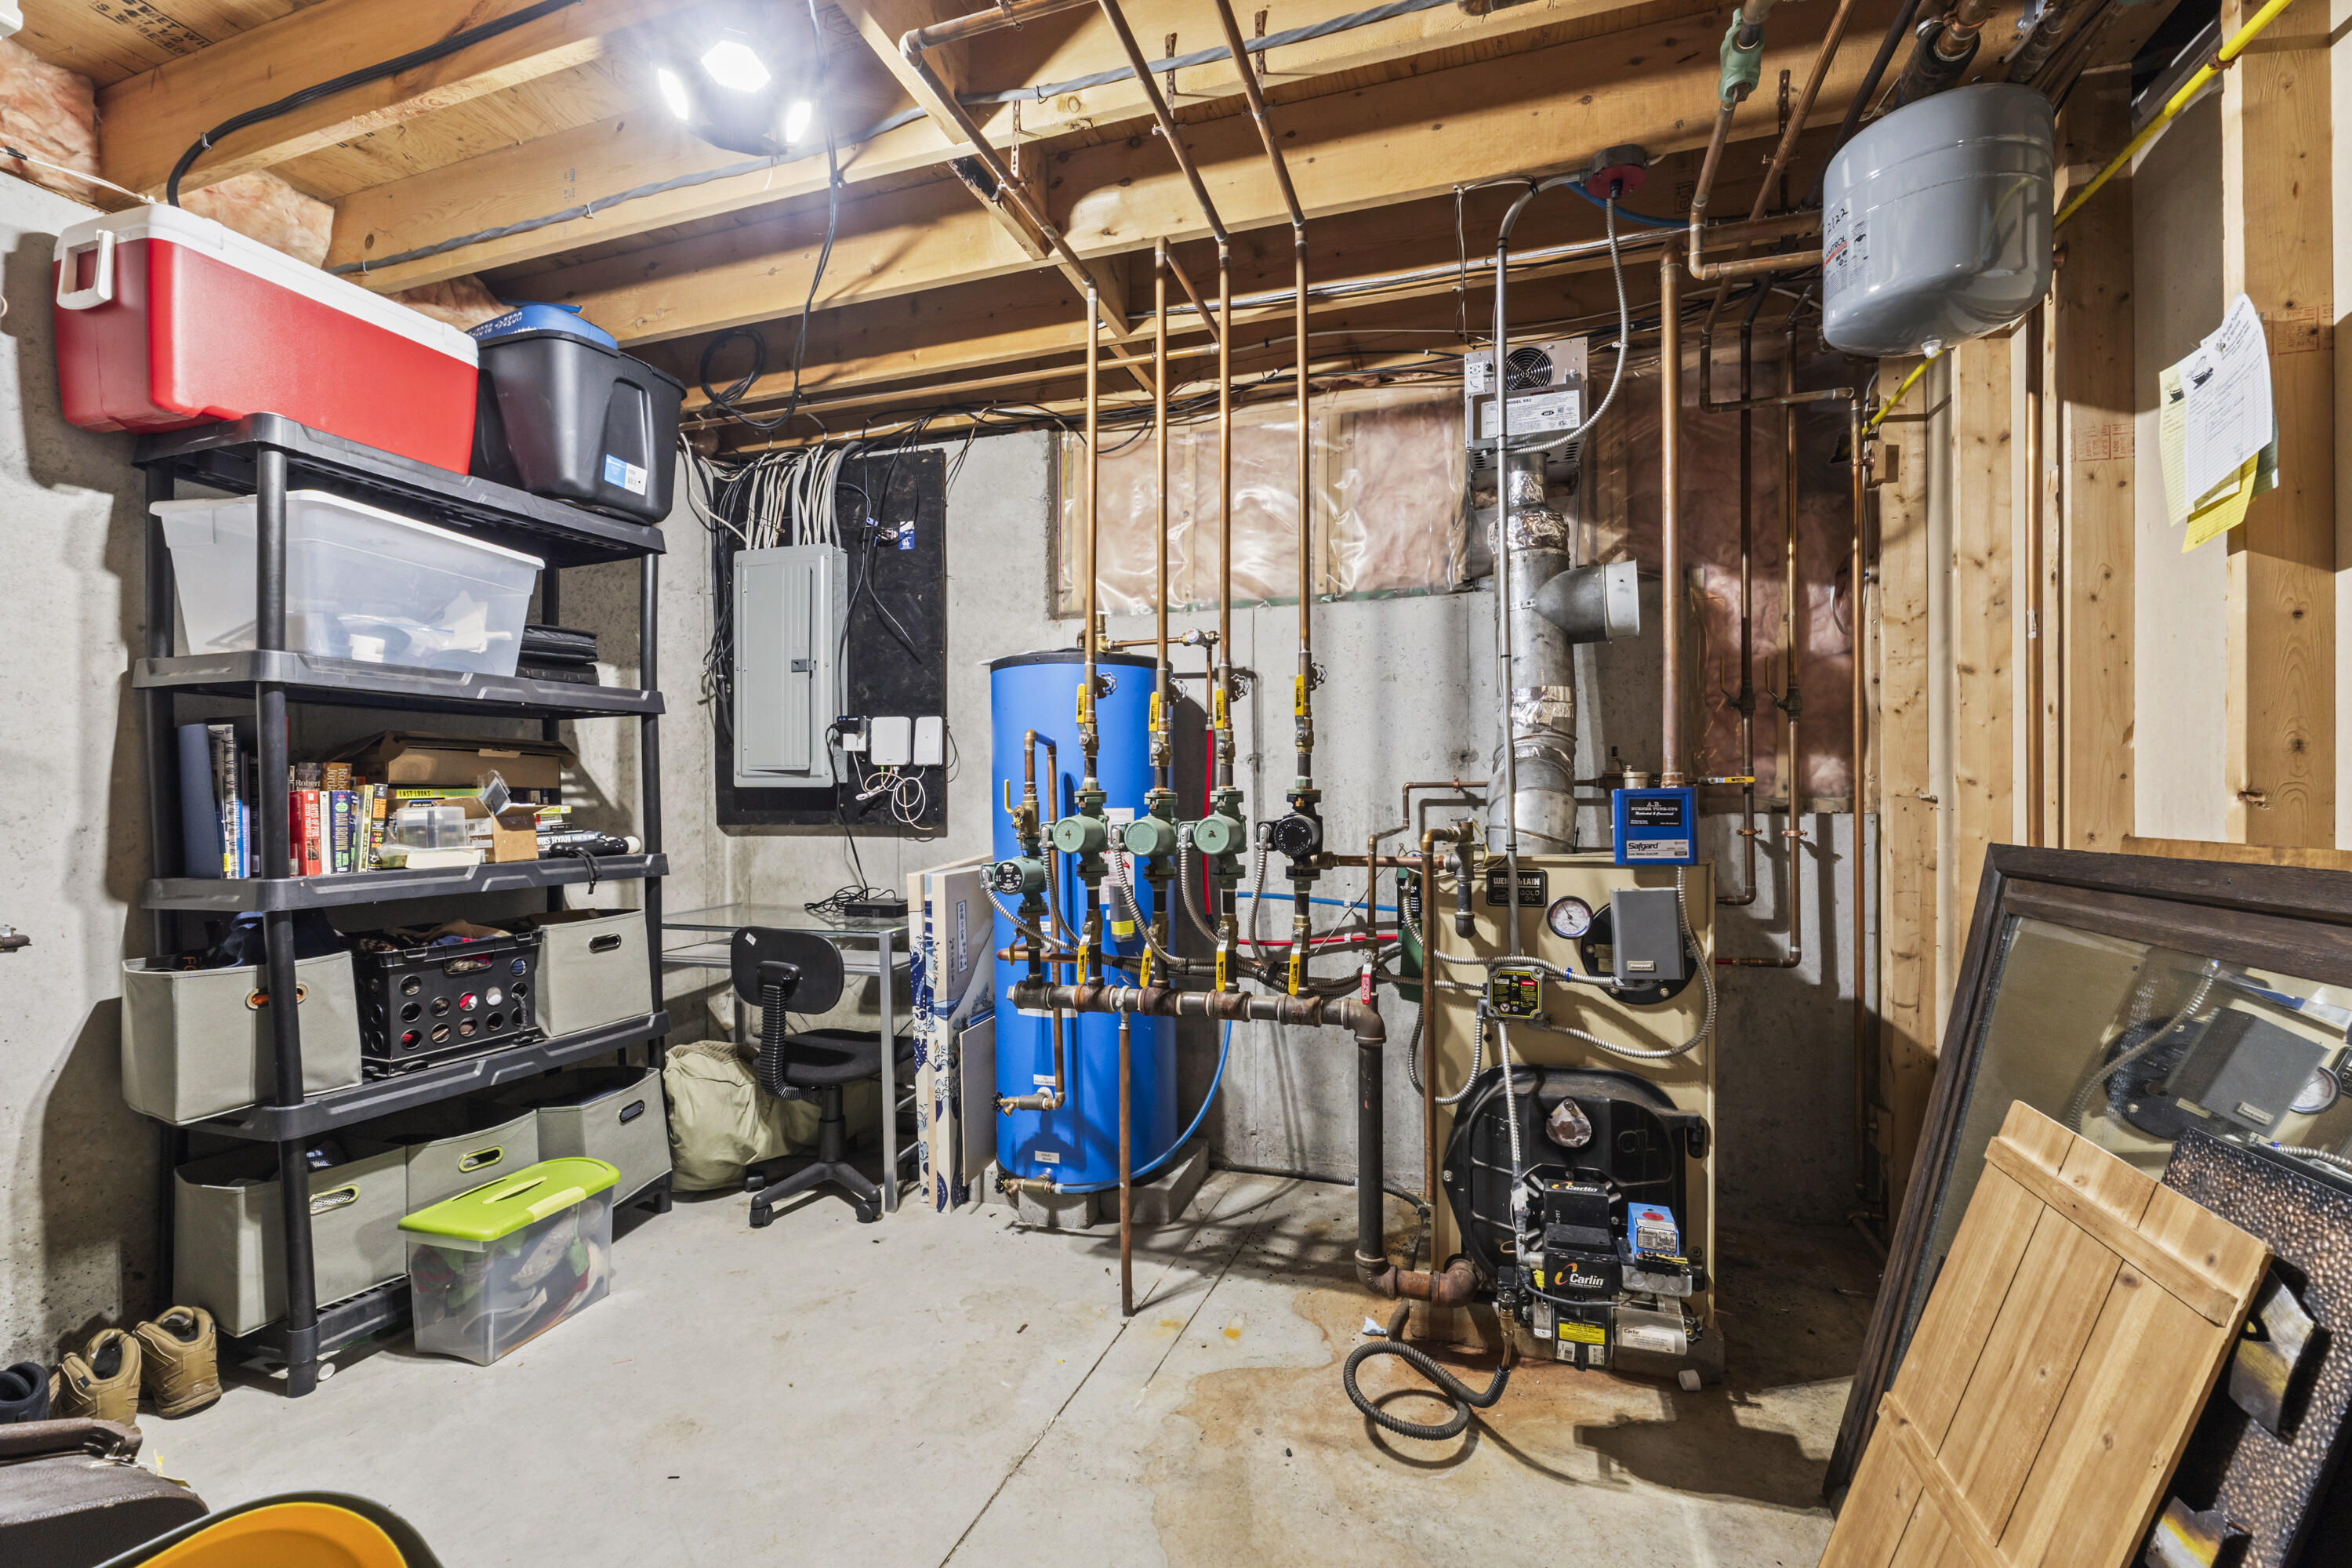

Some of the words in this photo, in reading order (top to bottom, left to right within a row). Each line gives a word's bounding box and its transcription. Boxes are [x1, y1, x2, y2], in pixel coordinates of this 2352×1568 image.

[1827, 208, 1849, 236] 2122
[327, 768, 337, 790] Jorda
[336, 812, 348, 826] DAN
[336, 826, 348, 851] BROWN
[551, 835, 572, 844] RYAN
[1065, 829, 1072, 840] 4
[1628, 842, 1659, 851] Safgard
[1618, 1130, 1657, 1155] OIL
[1570, 1272, 1604, 1286] Carlin
